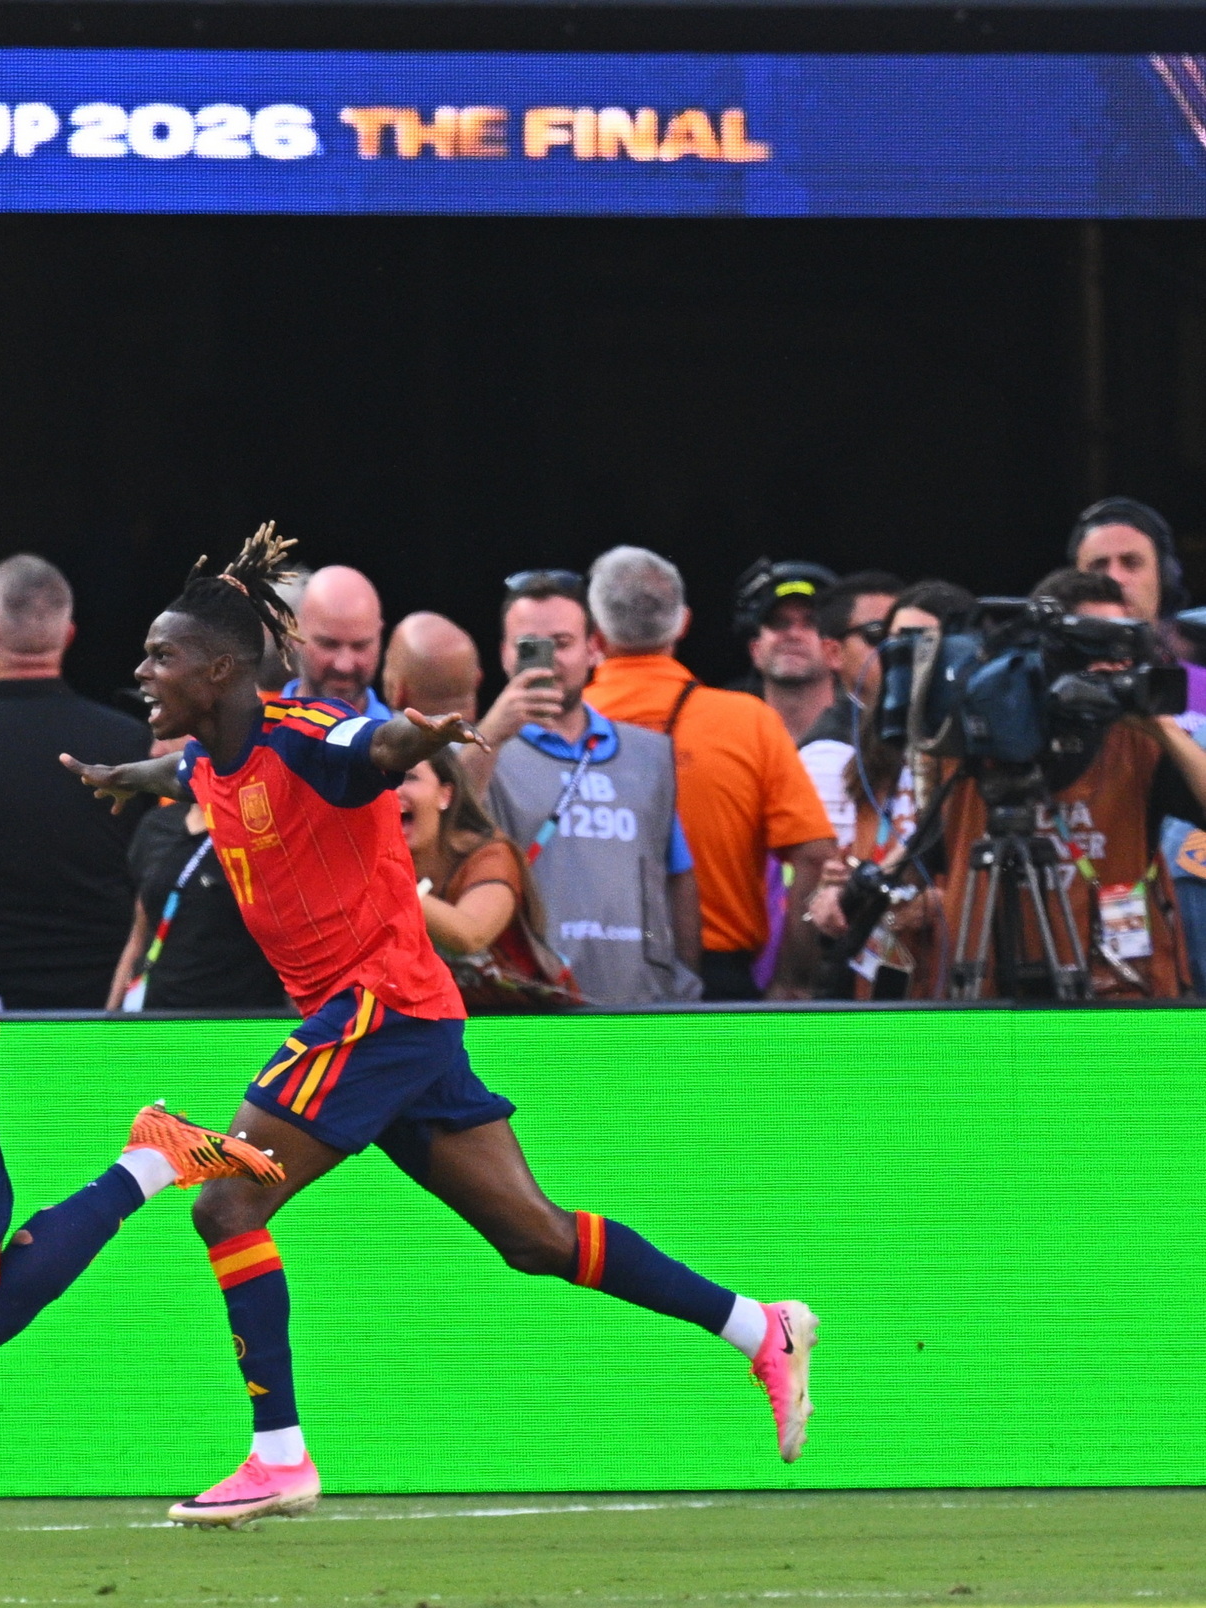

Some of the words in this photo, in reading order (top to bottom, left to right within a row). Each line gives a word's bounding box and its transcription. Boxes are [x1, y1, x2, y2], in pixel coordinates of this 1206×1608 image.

[67, 102, 320, 159] 2026
[340, 106, 508, 160] THE
[524, 107, 771, 162] FINAL
[559, 804, 638, 842] 1290
[220, 847, 254, 904] 17
[252, 1036, 309, 1088] 7
